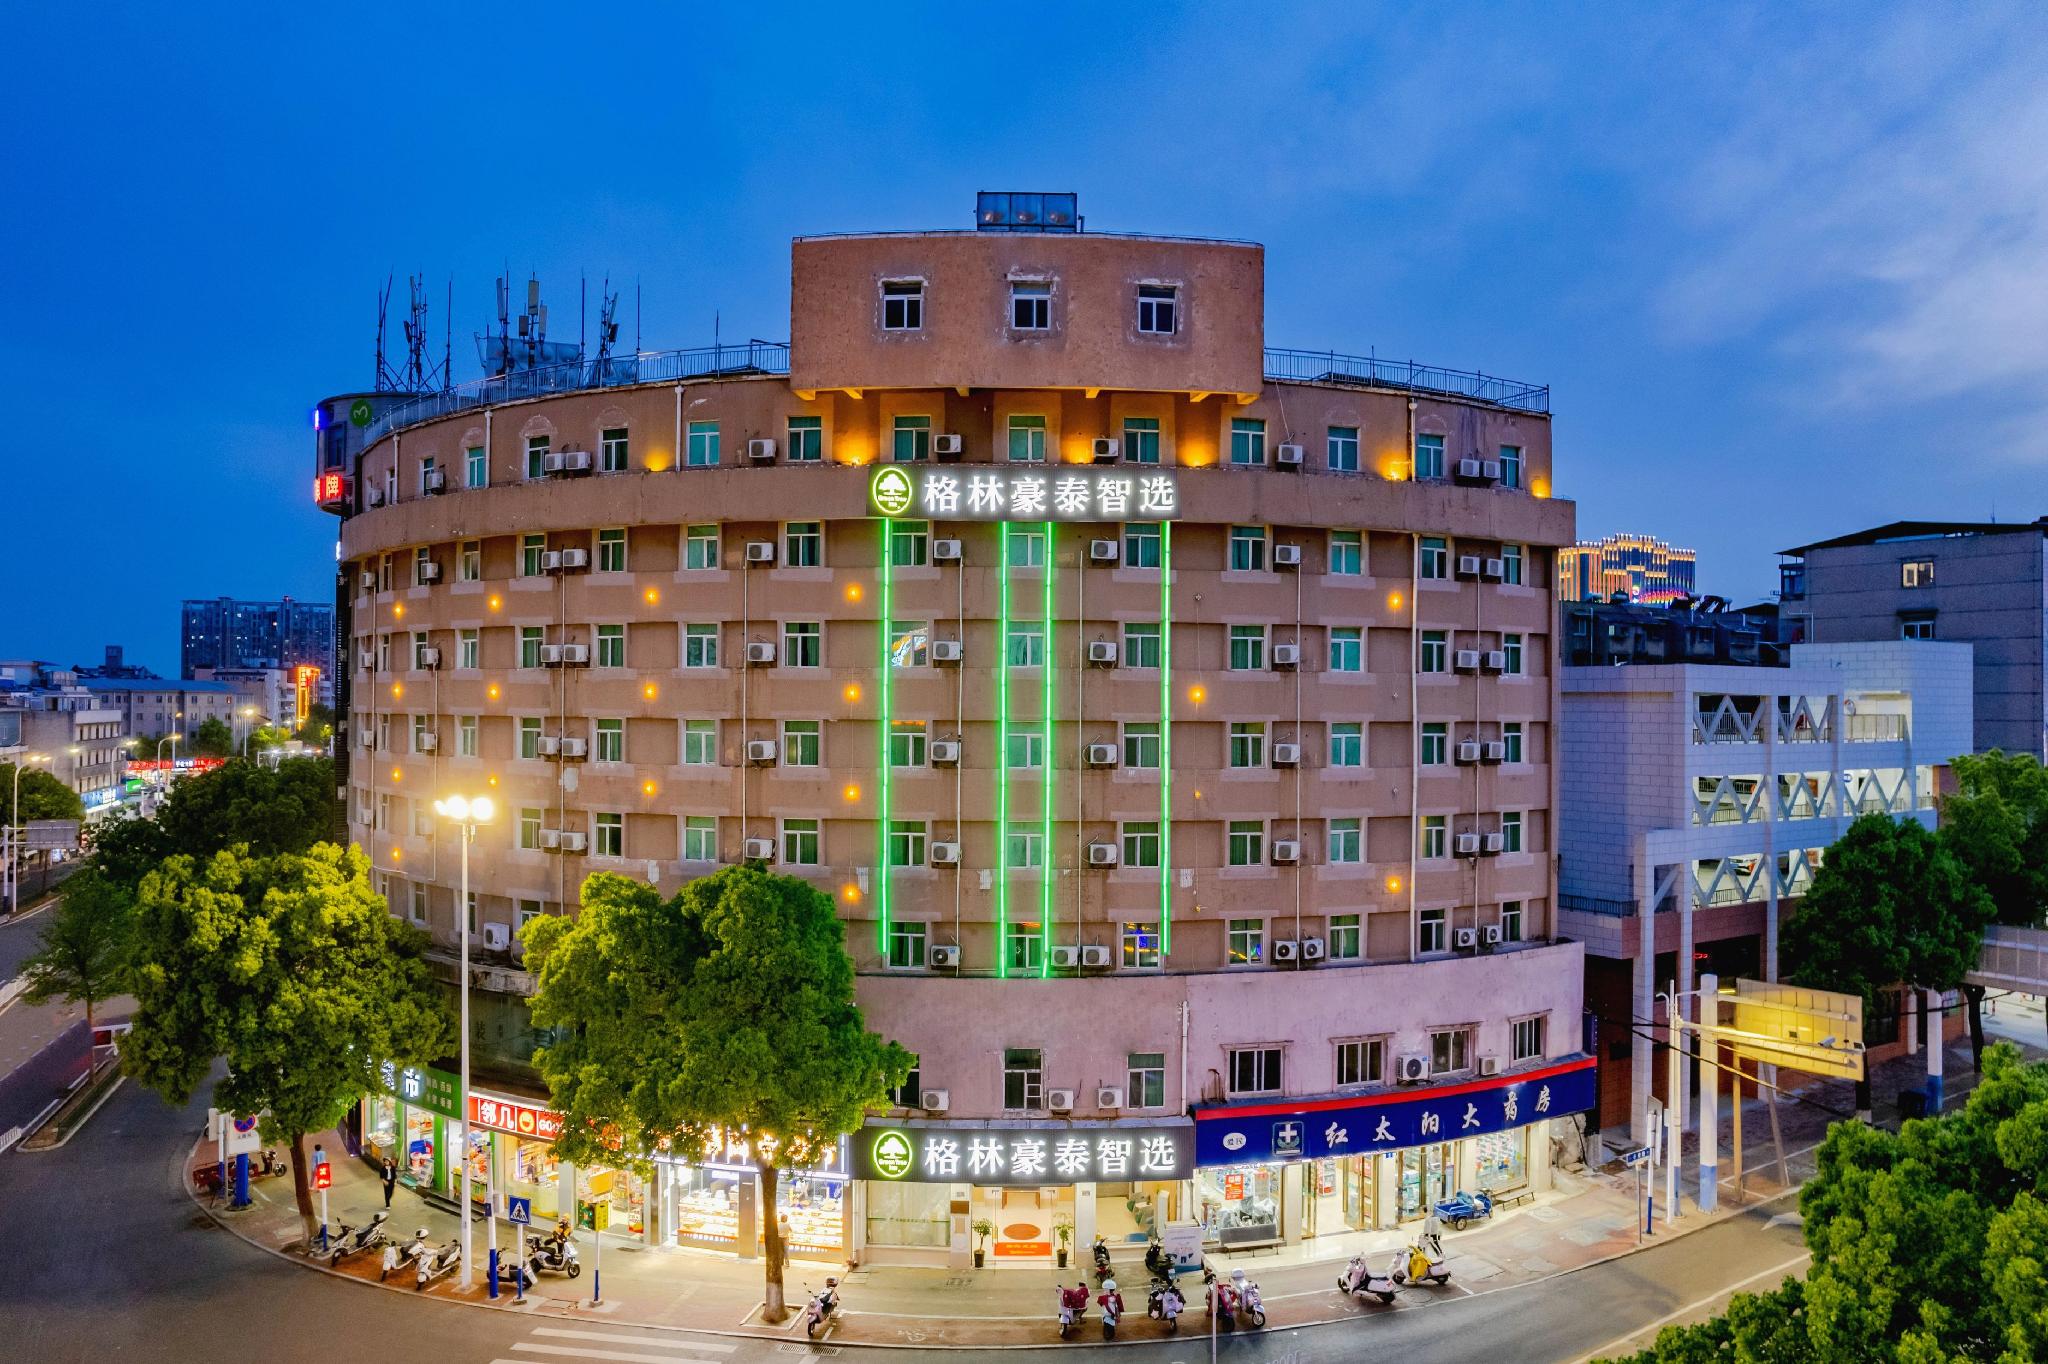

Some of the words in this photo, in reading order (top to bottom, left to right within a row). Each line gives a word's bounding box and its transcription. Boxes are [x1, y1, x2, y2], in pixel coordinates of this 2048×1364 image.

[924, 475, 1175, 513] 格林豪泰智选
[480, 1101, 515, 1130] 邻几
[1325, 1084, 1551, 1149] 红太阳大药房
[924, 1138, 1176, 1176] 格林豪泰智选
